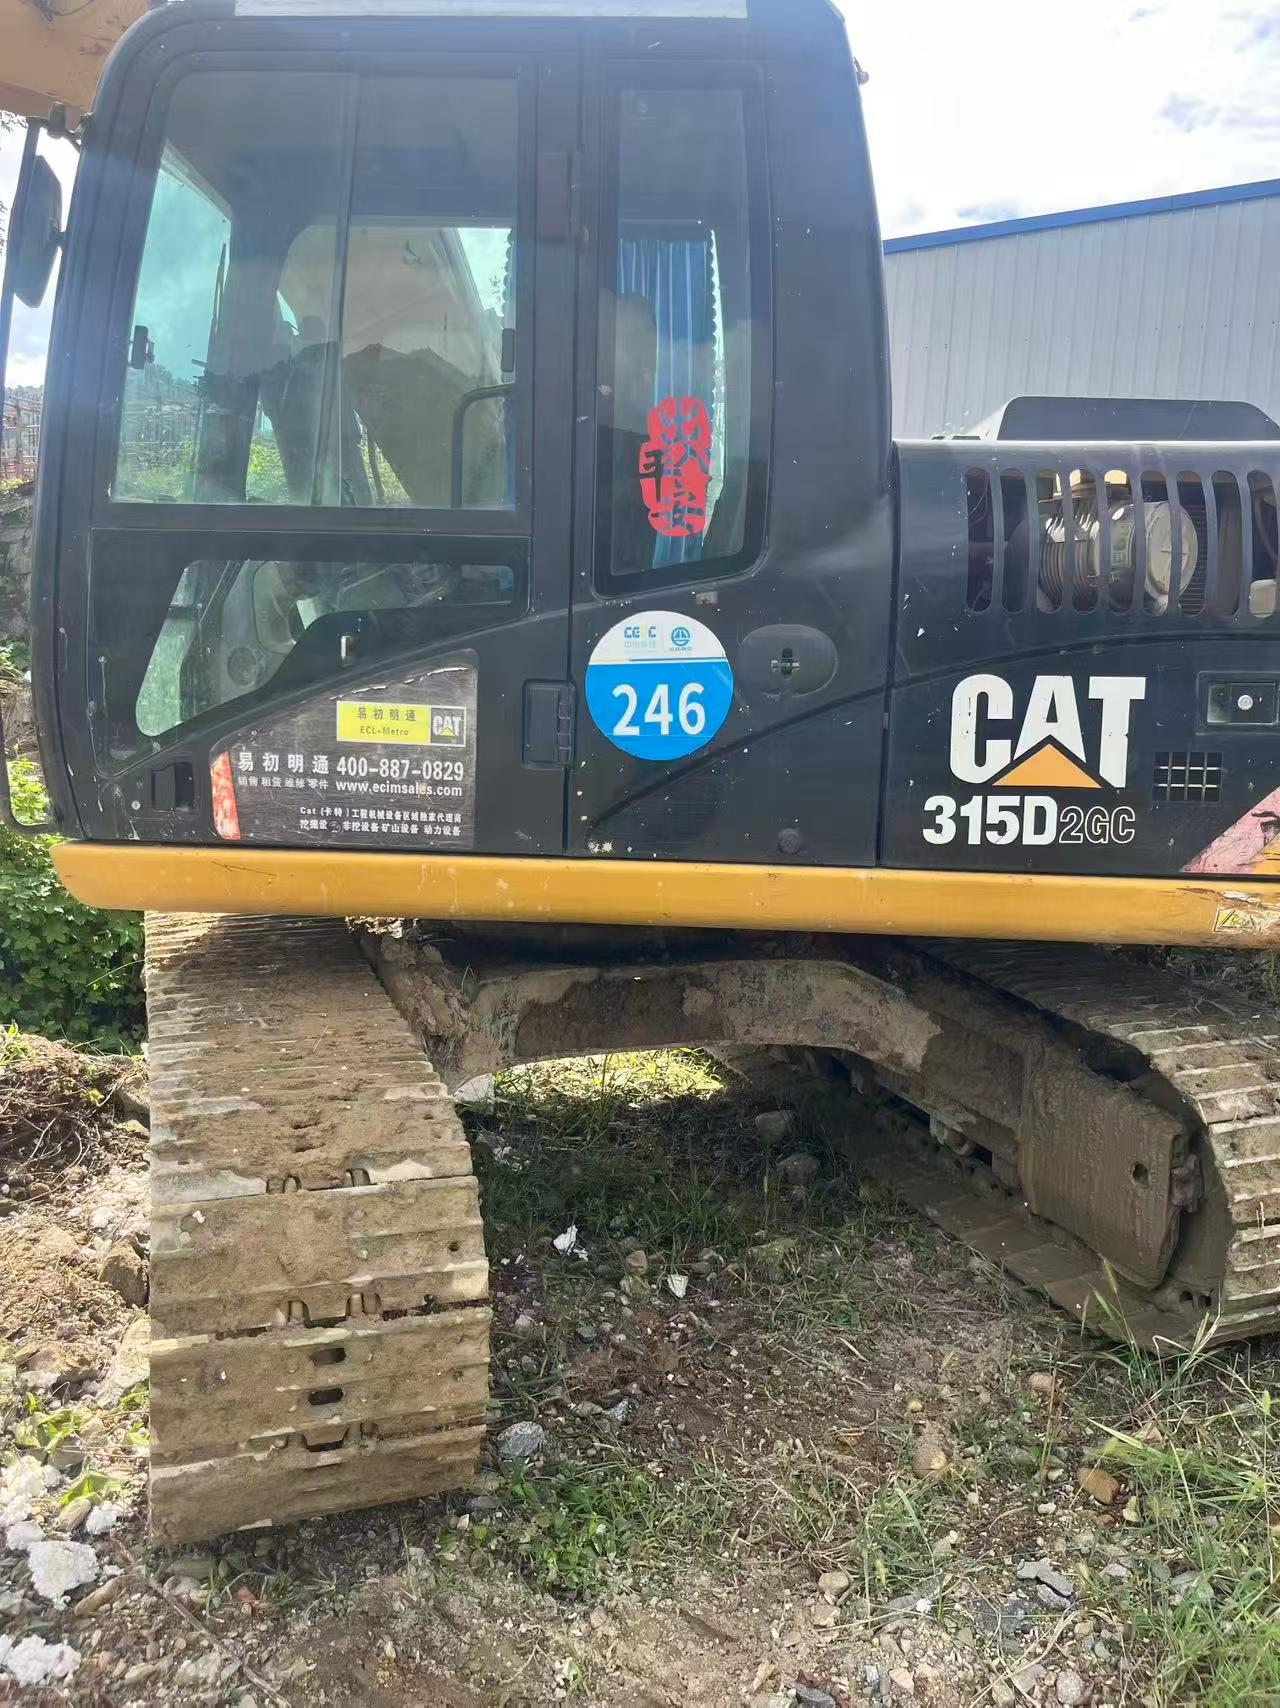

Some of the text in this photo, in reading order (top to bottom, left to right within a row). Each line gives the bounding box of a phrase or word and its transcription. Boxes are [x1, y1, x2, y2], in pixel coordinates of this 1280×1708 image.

[358, 707, 416, 721] 易初明通
[612, 682, 706, 736] 246
[360, 725, 409, 736] ECL-Metro
[433, 715, 462, 736] CAT
[950, 673, 1147, 788] CAT
[238, 752, 329, 774] 易初明通
[336, 756, 464, 781] 400-887-0829
[300, 806, 317, 815] Cat
[300, 819, 337, 831] 挖掘设
